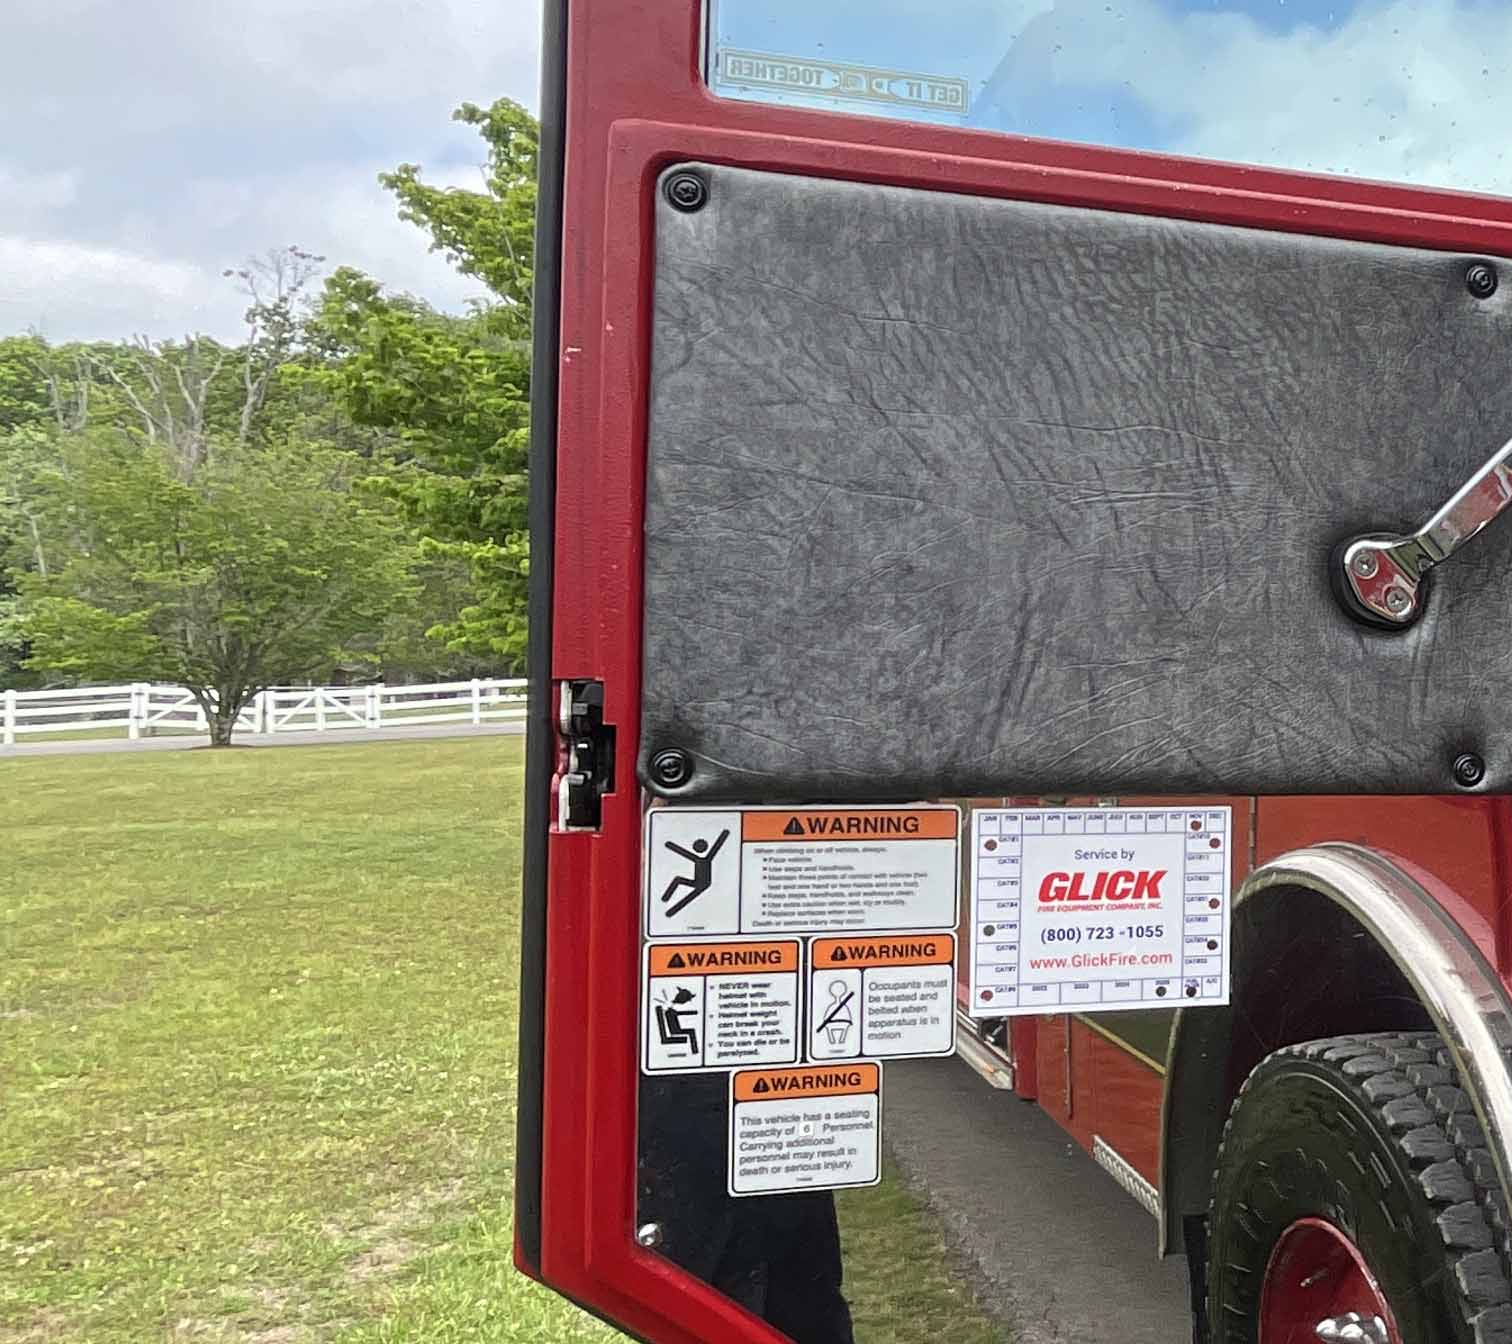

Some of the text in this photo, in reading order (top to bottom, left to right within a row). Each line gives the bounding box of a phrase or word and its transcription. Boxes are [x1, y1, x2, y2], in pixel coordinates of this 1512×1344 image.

[807, 816, 919, 834] WARNING
[1075, 848, 1134, 861] Service by
[1039, 870, 1168, 902] GLICK
[1057, 904, 1104, 912] EQUIPMENT
[1041, 925, 1163, 944] (800) 723 -1055
[688, 950, 782, 966] WARNING
[849, 943, 936, 958] WARNING
[1030, 953, 1172, 969] www.GlickFire.com
[869, 982, 921, 991] Occupants
[869, 992, 938, 1003] be seated and
[868, 1006, 898, 1015] belted
[868, 1019, 916, 1028] apparatus
[931, 1016, 939, 1024] in
[771, 1073, 861, 1091] WARNING
[741, 1117, 761, 1126] This
[764, 1115, 800, 1124] vehicle
[834, 1110, 870, 1119] seating
[740, 1128, 782, 1138] capacity
[785, 1127, 795, 1135] of
[823, 1122, 873, 1132] Personnel
[740, 1137, 834, 1151] Carrying additional
[739, 1153, 790, 1165] personnel
[793, 1152, 815, 1160] may
[817, 1147, 845, 1157] result
[739, 1167, 768, 1176] death
[785, 1162, 821, 1173] serious
